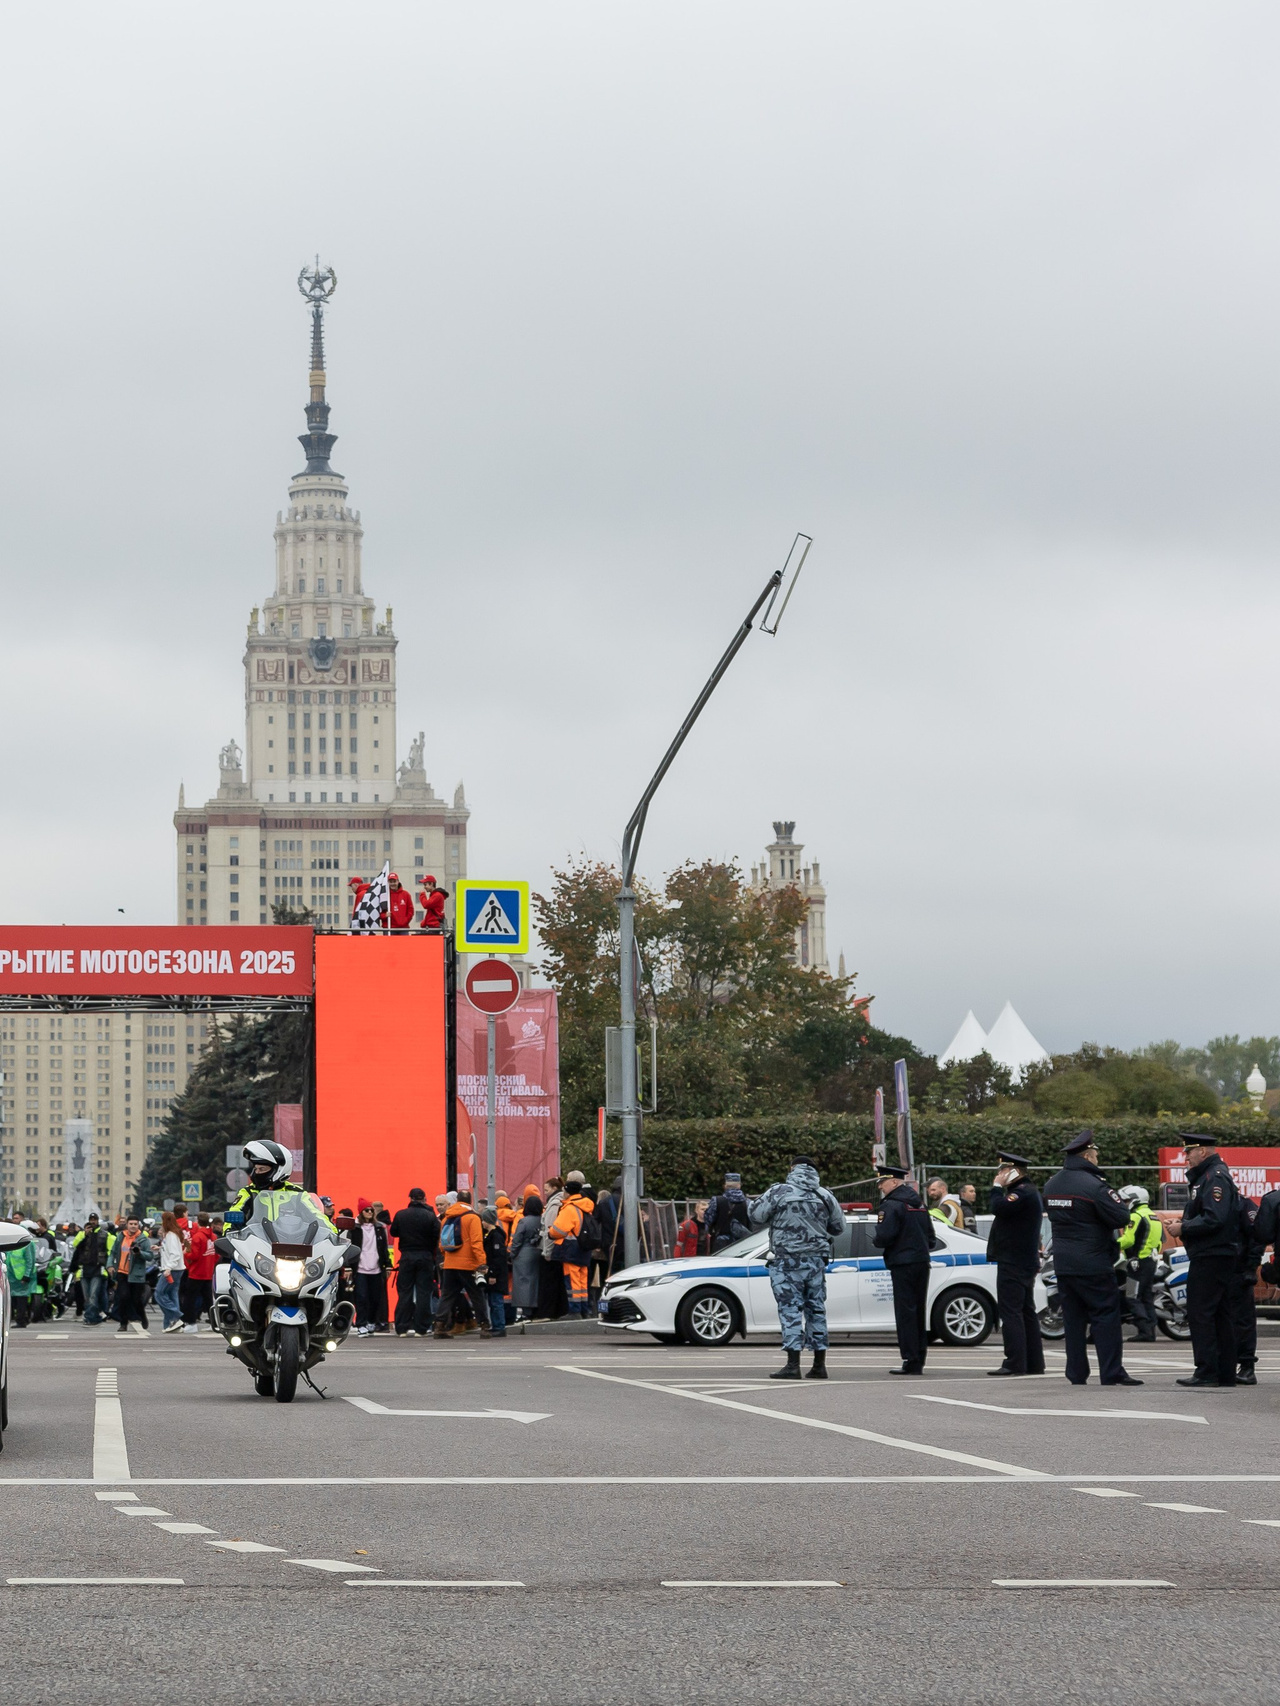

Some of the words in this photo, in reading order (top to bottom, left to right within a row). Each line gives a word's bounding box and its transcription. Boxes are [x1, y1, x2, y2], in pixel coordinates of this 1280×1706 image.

[80, 949, 234, 974] МОТОСЕЗОНА
[240, 949, 296, 974] 2025
[458, 1074, 526, 1086] МОСКВСКИЙ
[526, 1105, 551, 1117] 2025
